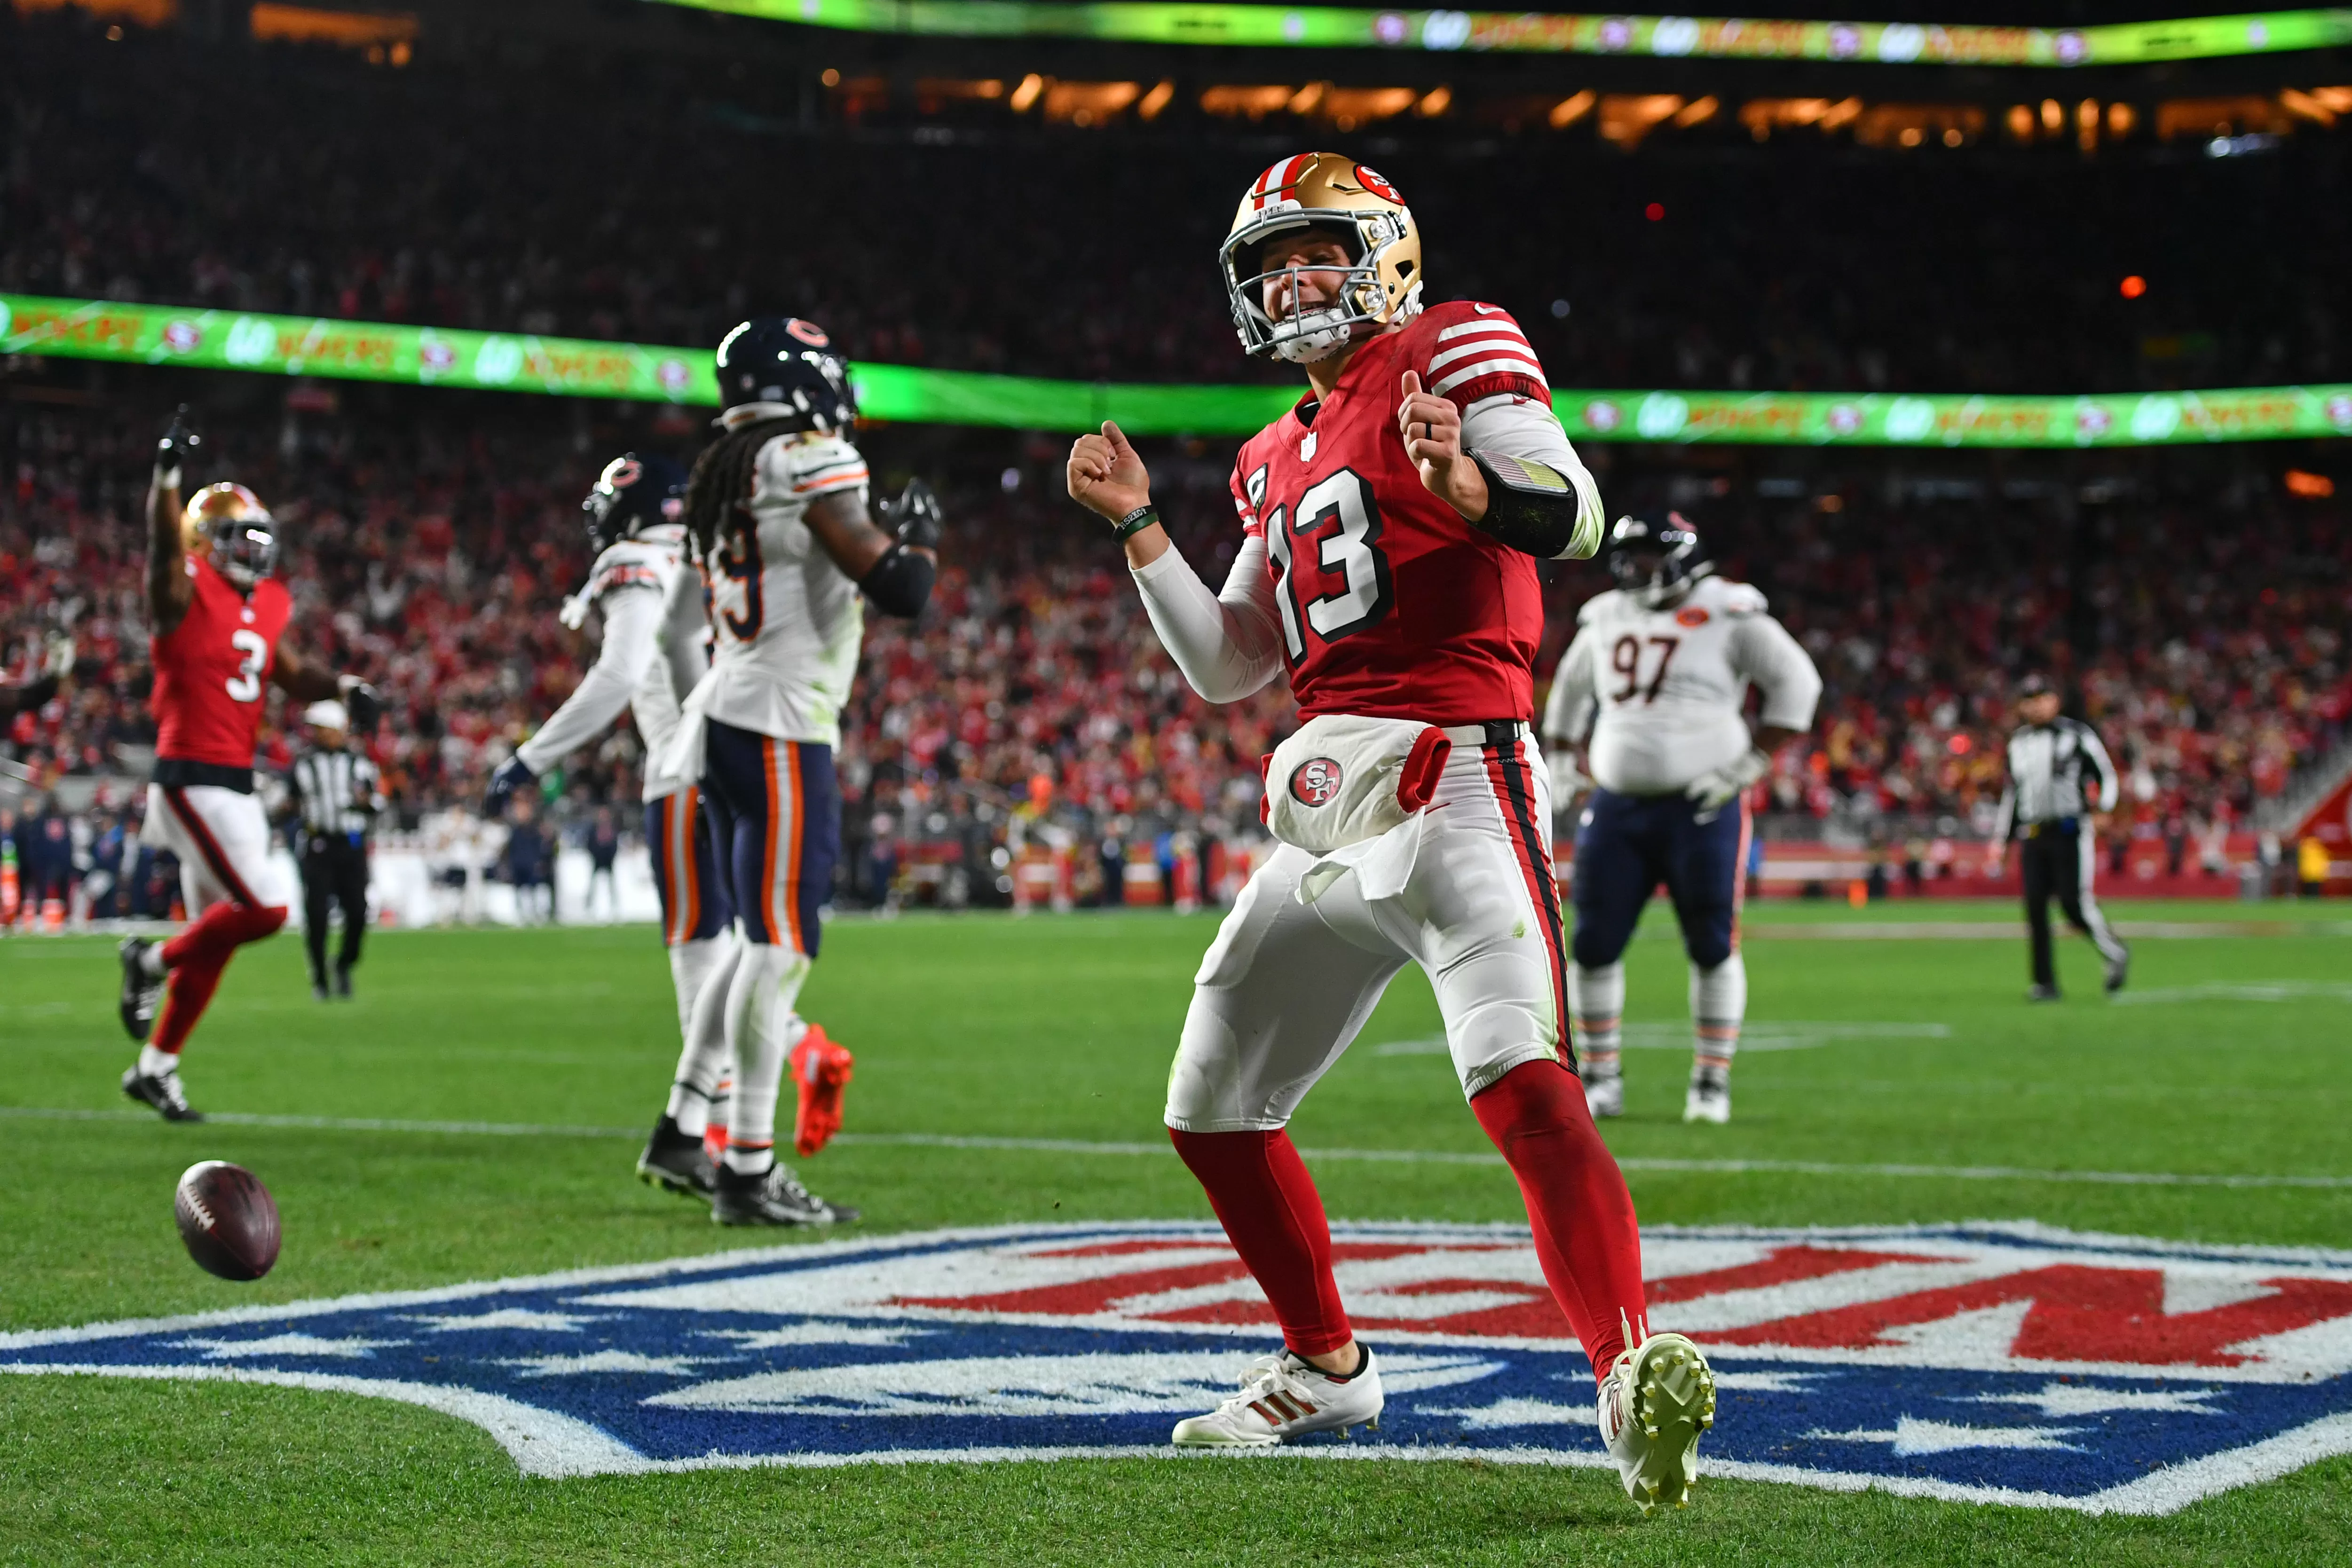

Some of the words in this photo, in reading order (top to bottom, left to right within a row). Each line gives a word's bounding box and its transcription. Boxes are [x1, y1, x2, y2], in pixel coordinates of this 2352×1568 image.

[1266, 466, 1394, 669] 13
[225, 629, 267, 702] 3
[1612, 634, 1680, 704] 97
[1305, 764, 1336, 802] SF
